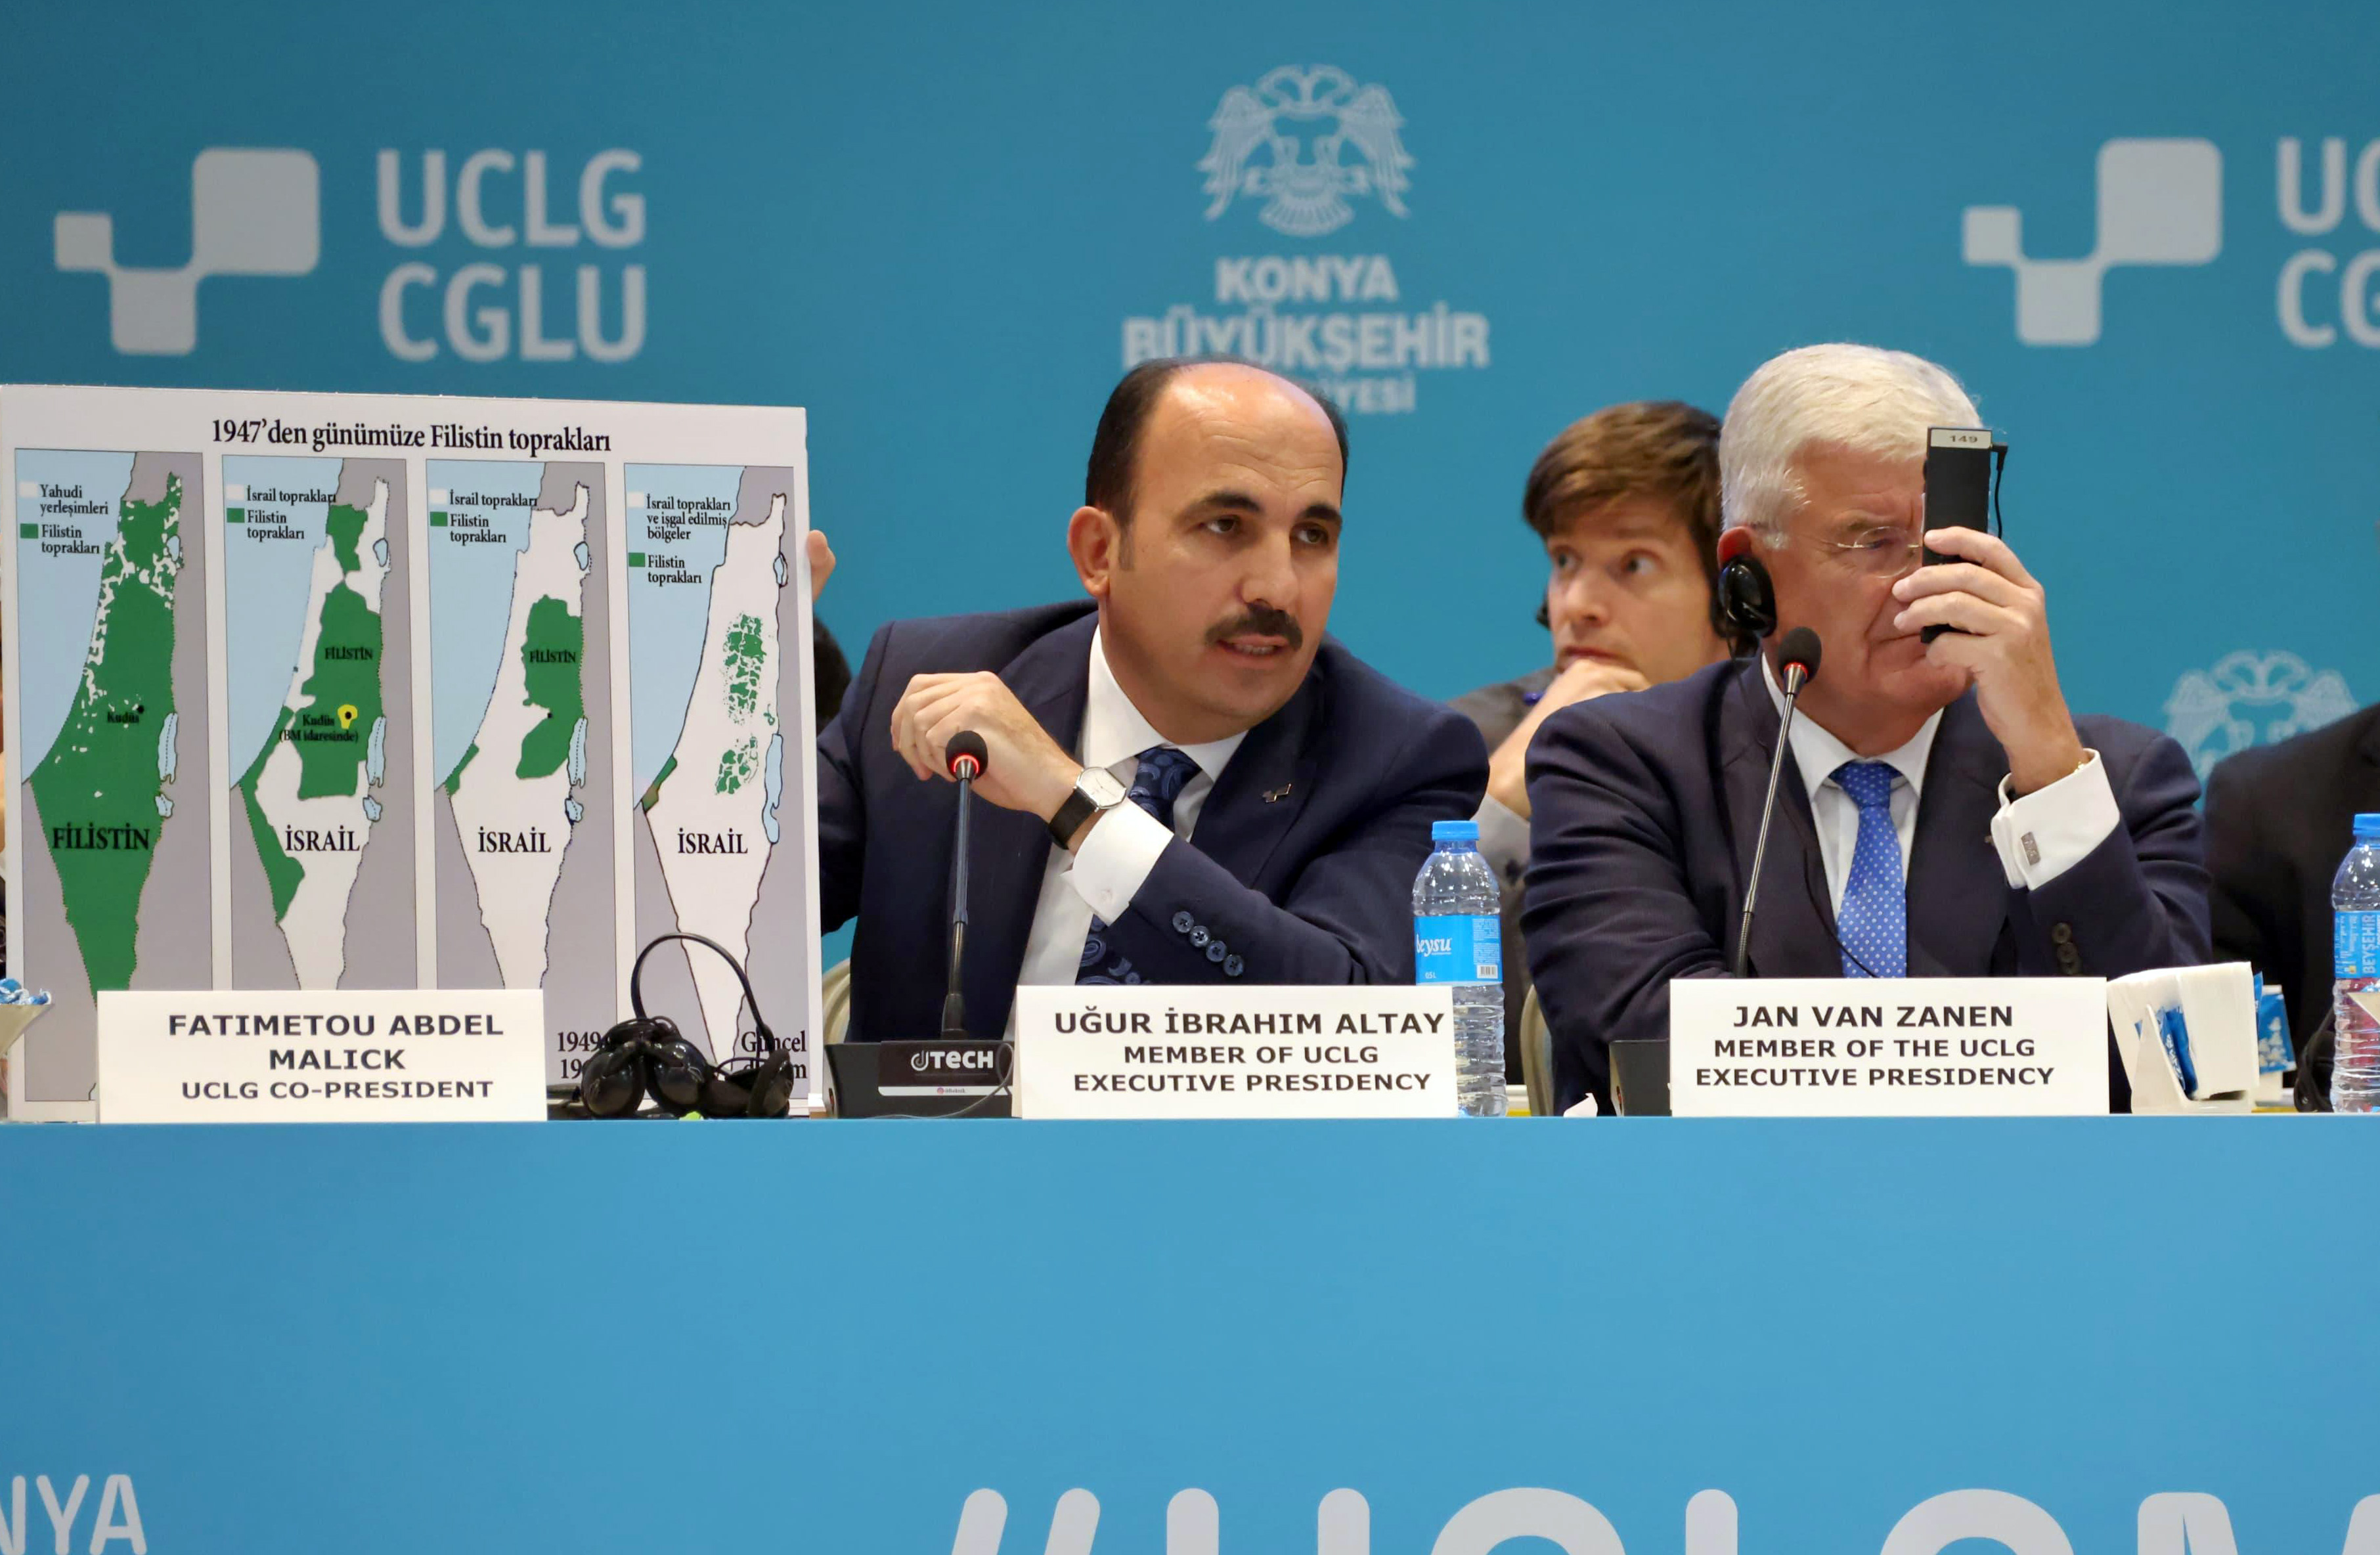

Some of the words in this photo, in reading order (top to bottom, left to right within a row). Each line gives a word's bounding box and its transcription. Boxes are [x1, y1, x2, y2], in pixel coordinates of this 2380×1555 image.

[377, 149, 646, 248] UCLG
[1215, 255, 1399, 303] KONYA
[379, 263, 646, 362] CGLU
[1122, 301, 1489, 373] BÜYÜKŞEHİR
[312, 422, 425, 452] günümüze
[430, 424, 504, 449] Filistin
[508, 426, 611, 458] toprakları
[1950, 435, 1978, 443] 149
[40, 485, 83, 499] Yahudi
[246, 487, 277, 502] İsrail
[279, 489, 337, 505] toprakları
[449, 489, 478, 506] İsrail
[481, 493, 538, 508] toprakları
[40, 501, 108, 516] yerleşimleri
[646, 494, 675, 510] İsrail
[677, 496, 731, 513] toprakları
[247, 509, 287, 524] Filistin
[450, 514, 489, 528] Filistin
[647, 515, 659, 525] ve
[661, 512, 686, 528] işgal
[688, 513, 728, 529] edilmiş
[41, 525, 82, 539] Filistin
[247, 525, 305, 541] toprakları
[450, 529, 507, 546] toprakları
[647, 527, 692, 543] bölgeler
[41, 540, 100, 556] toprakları
[648, 555, 686, 569] Filistin
[648, 570, 702, 585] toprakları
[53, 822, 150, 850] FİLİSTİN
[285, 825, 360, 852] İSRAİL
[478, 826, 551, 853] İSRAİL
[678, 827, 748, 854] İSRAİL
[168, 1014, 374, 1036] FATIMETOU
[389, 1015, 504, 1036] ABDEL
[1055, 1005, 1152, 1034] UĞUR
[1335, 1013, 1445, 1034] ALTAY
[1733, 1006, 1798, 1027] JAN
[1811, 1006, 1882, 1027] VAN
[1897, 1006, 2013, 1027] ZANEN
[1124, 1046, 1246, 1063] MEMBER
[1256, 1046, 1293, 1064] OF
[1304, 1045, 1378, 1063] UCLG
[1714, 1040, 1836, 1057] MEMBER
[1846, 1040, 1884, 1057] OF
[1893, 1040, 1949, 1057] THE
[1960, 1039, 2035, 1057] UCLG
[269, 1049, 406, 1070] MALICK
[1074, 1074, 1235, 1092] EXECUTIVE
[1246, 1074, 1431, 1091] PRESIDENCY
[1696, 1068, 1857, 1087] EXECUTIVE
[1869, 1067, 2054, 1085] PRESIDENCY
[182, 1082, 258, 1099] UCLG
[270, 1081, 493, 1099] CO-PRESIDENT
